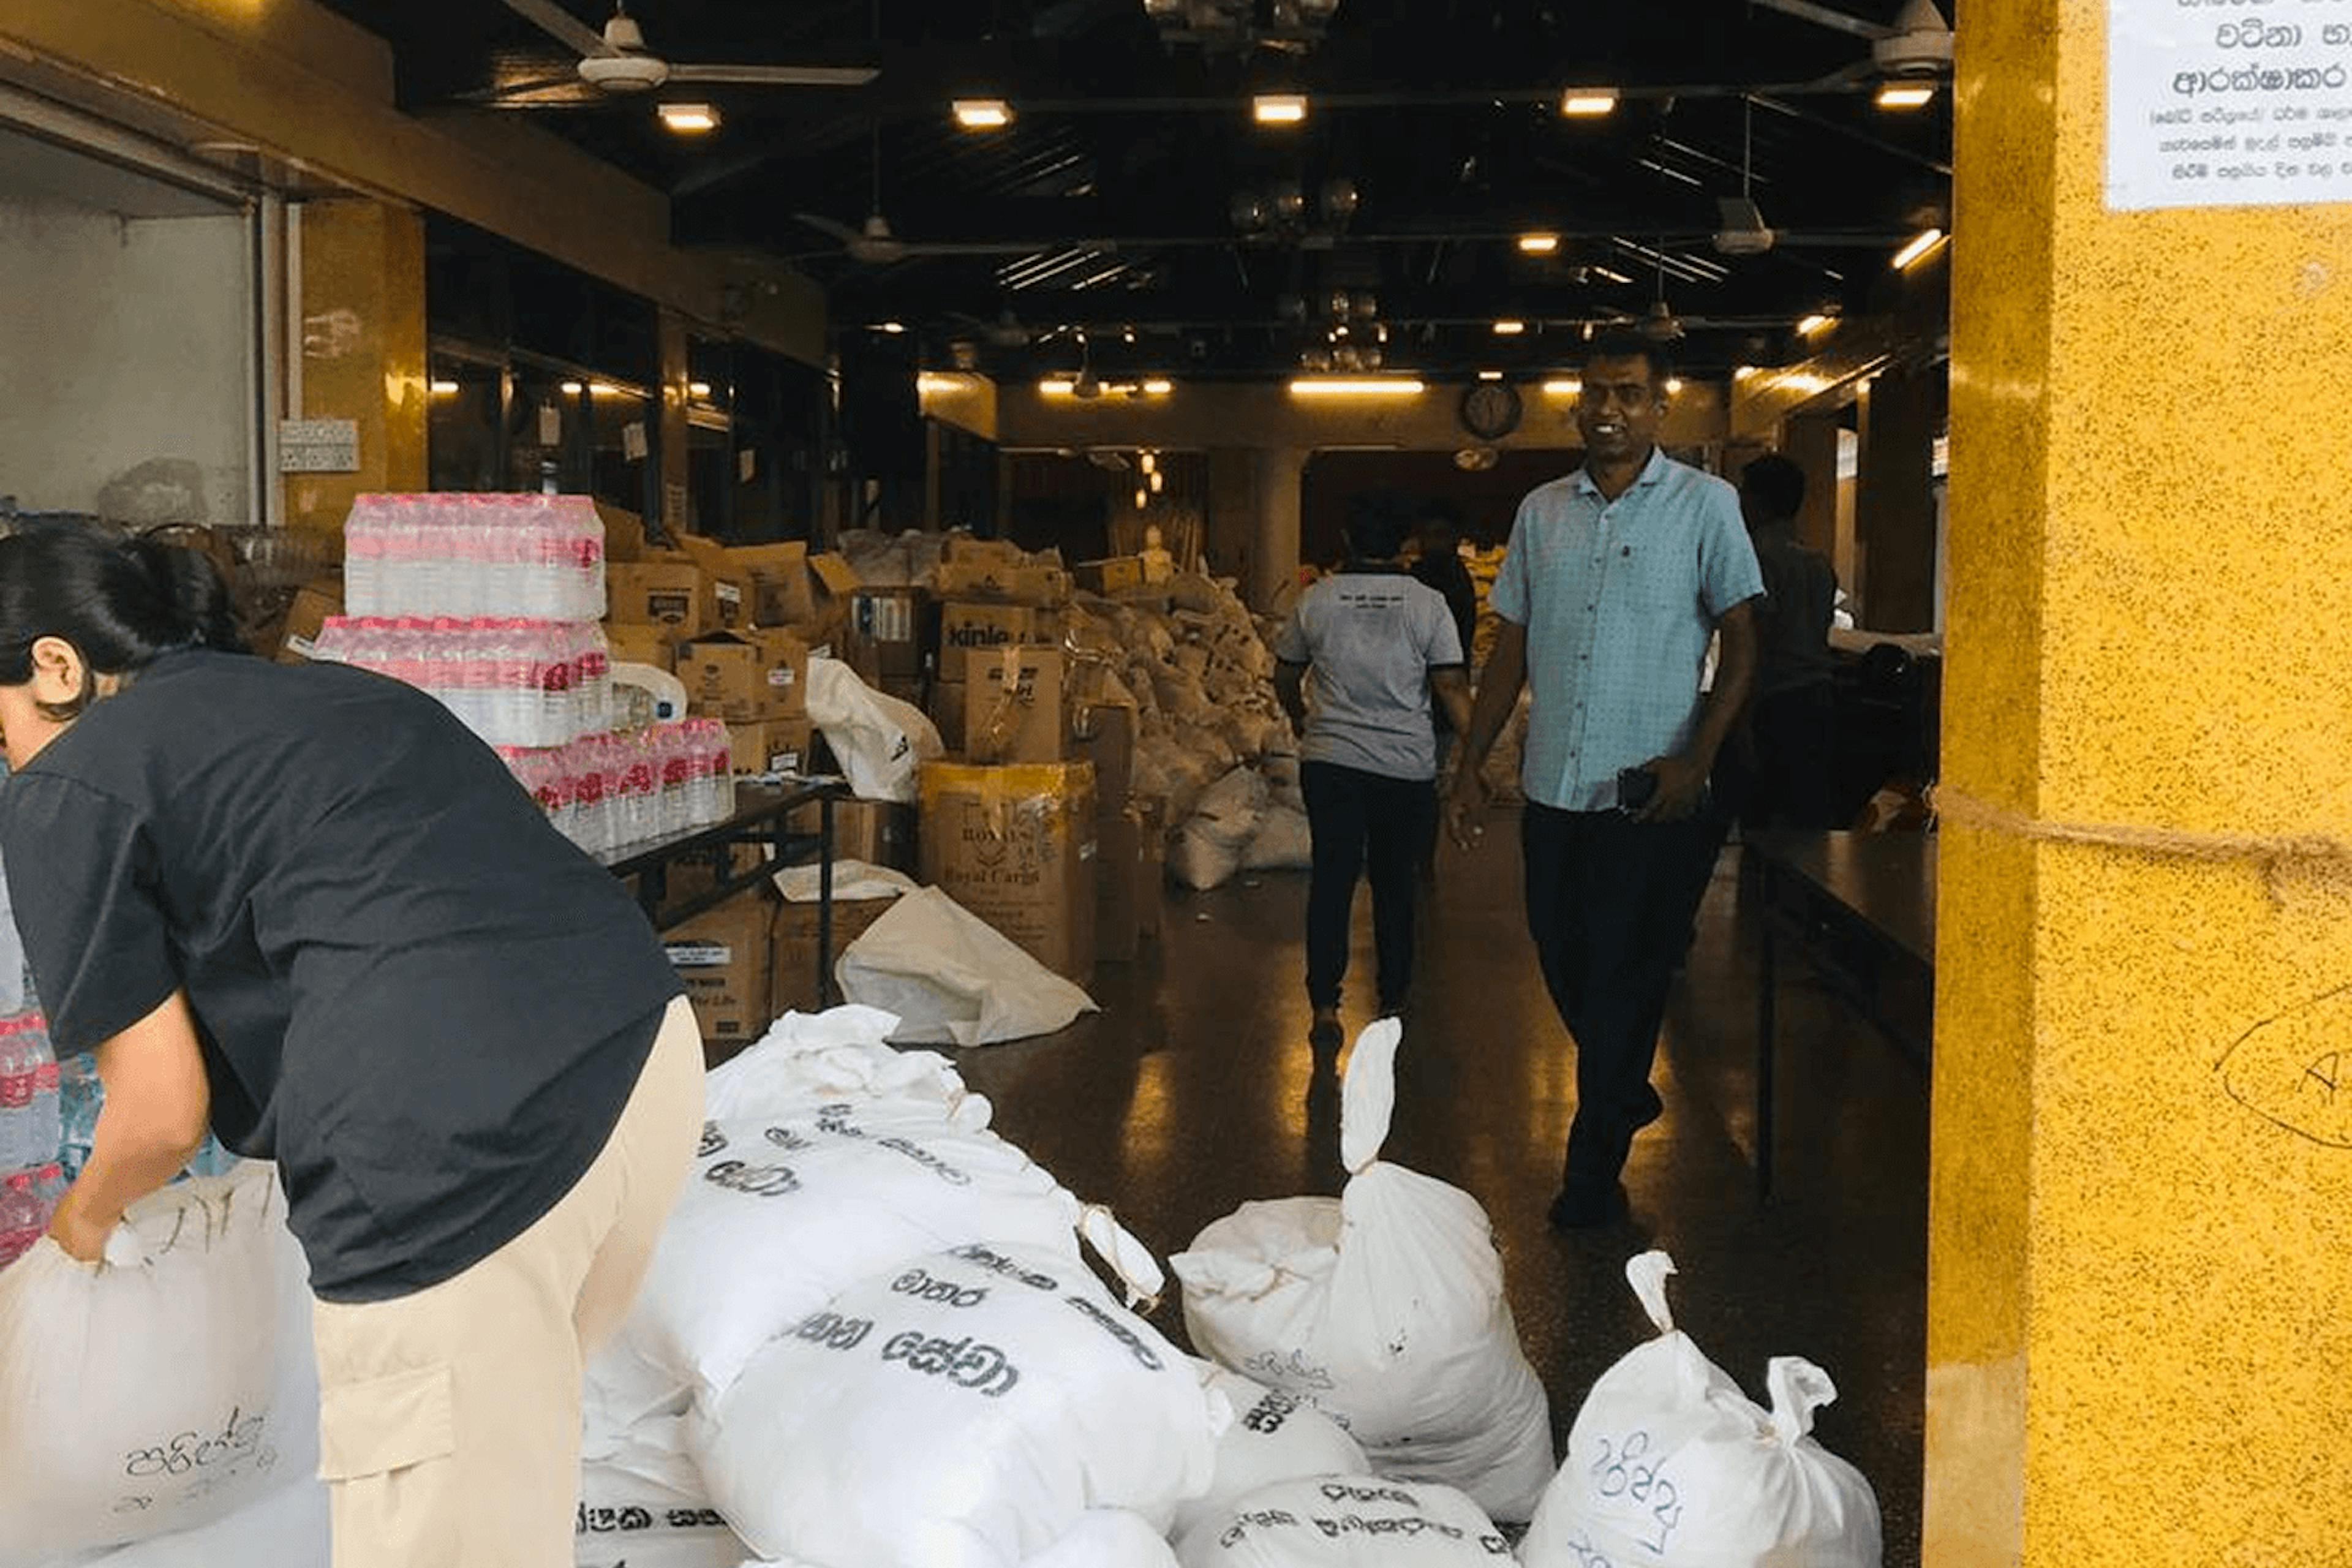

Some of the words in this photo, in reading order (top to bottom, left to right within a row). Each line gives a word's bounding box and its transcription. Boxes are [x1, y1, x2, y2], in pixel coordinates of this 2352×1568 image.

[2216, 18, 2302, 48] වටිනා
[2173, 62, 2347, 97] ආරක්ෂාකර
[881, 1330, 1019, 1398] සේවා
